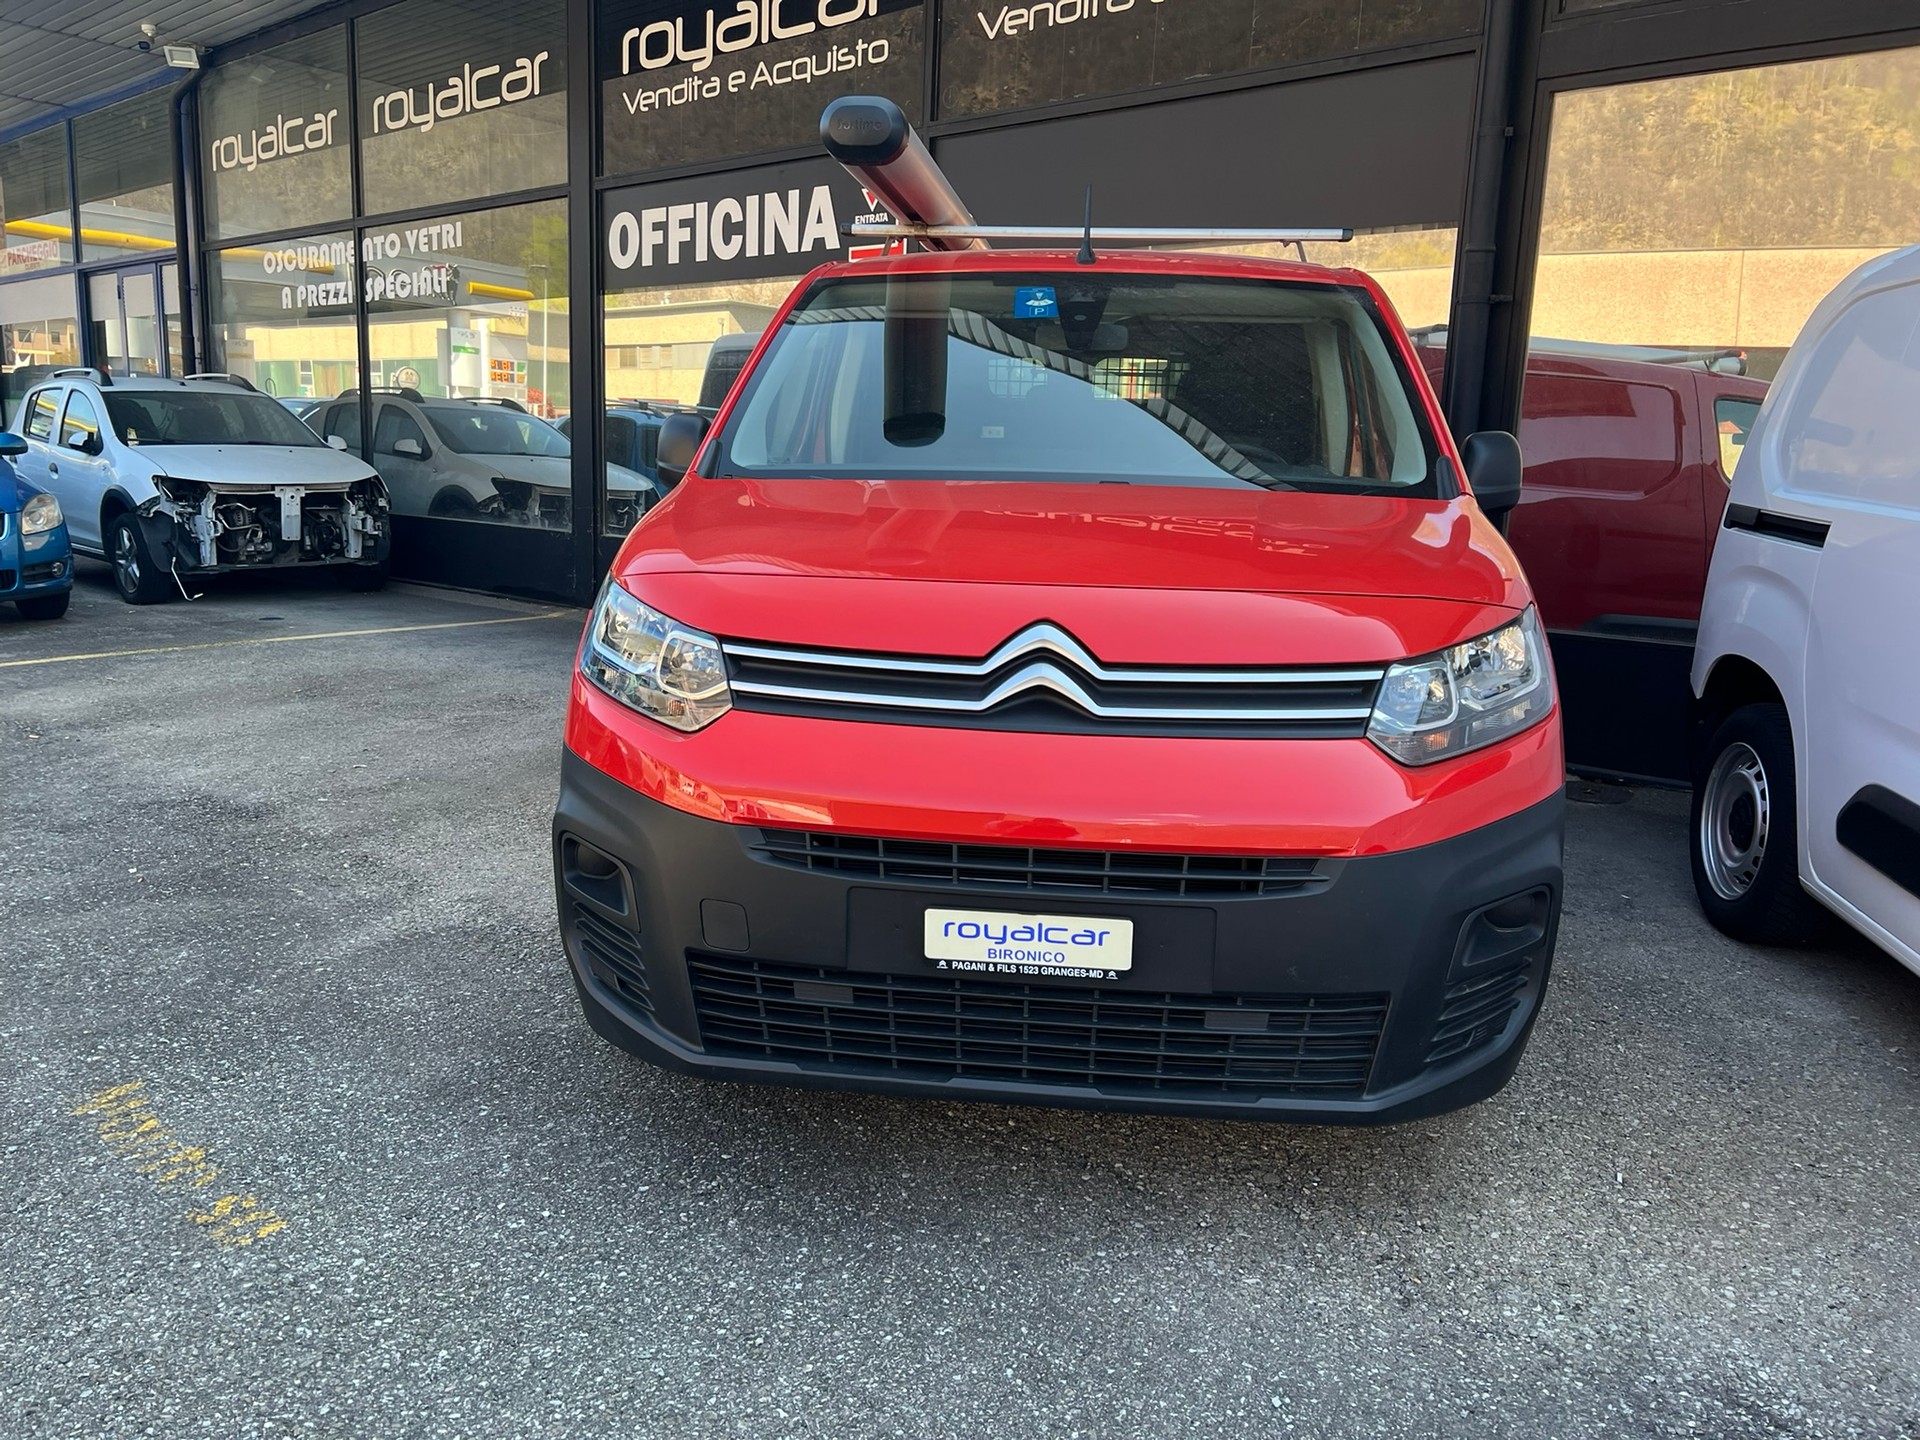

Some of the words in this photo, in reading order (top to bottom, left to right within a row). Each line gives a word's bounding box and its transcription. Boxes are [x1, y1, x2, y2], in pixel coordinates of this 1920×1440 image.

[621, 74, 721, 116] Vendita
[727, 69, 747, 93] e
[749, 37, 890, 91] Acquisto
[607, 184, 841, 270] OFFICINA
[854, 212, 889, 225] ENTRATA
[262, 231, 401, 275] OSCURAMENTO
[405, 220, 463, 255] VETRI
[281, 286, 293, 310] A
[296, 279, 354, 309] PREZZI
[364, 267, 448, 303] SPECIALI
[1034, 307, 1045, 316] P
[943, 920, 1111, 947] royalcar
[987, 947, 1066, 964] BIRONICO
[951, 960, 987, 973] PAGANI
[988, 964, 995, 972] &
[996, 963, 1017, 974] FILS
[1018, 965, 1039, 975] 1523
[1040, 966, 1104, 980] GRANGES-MD
